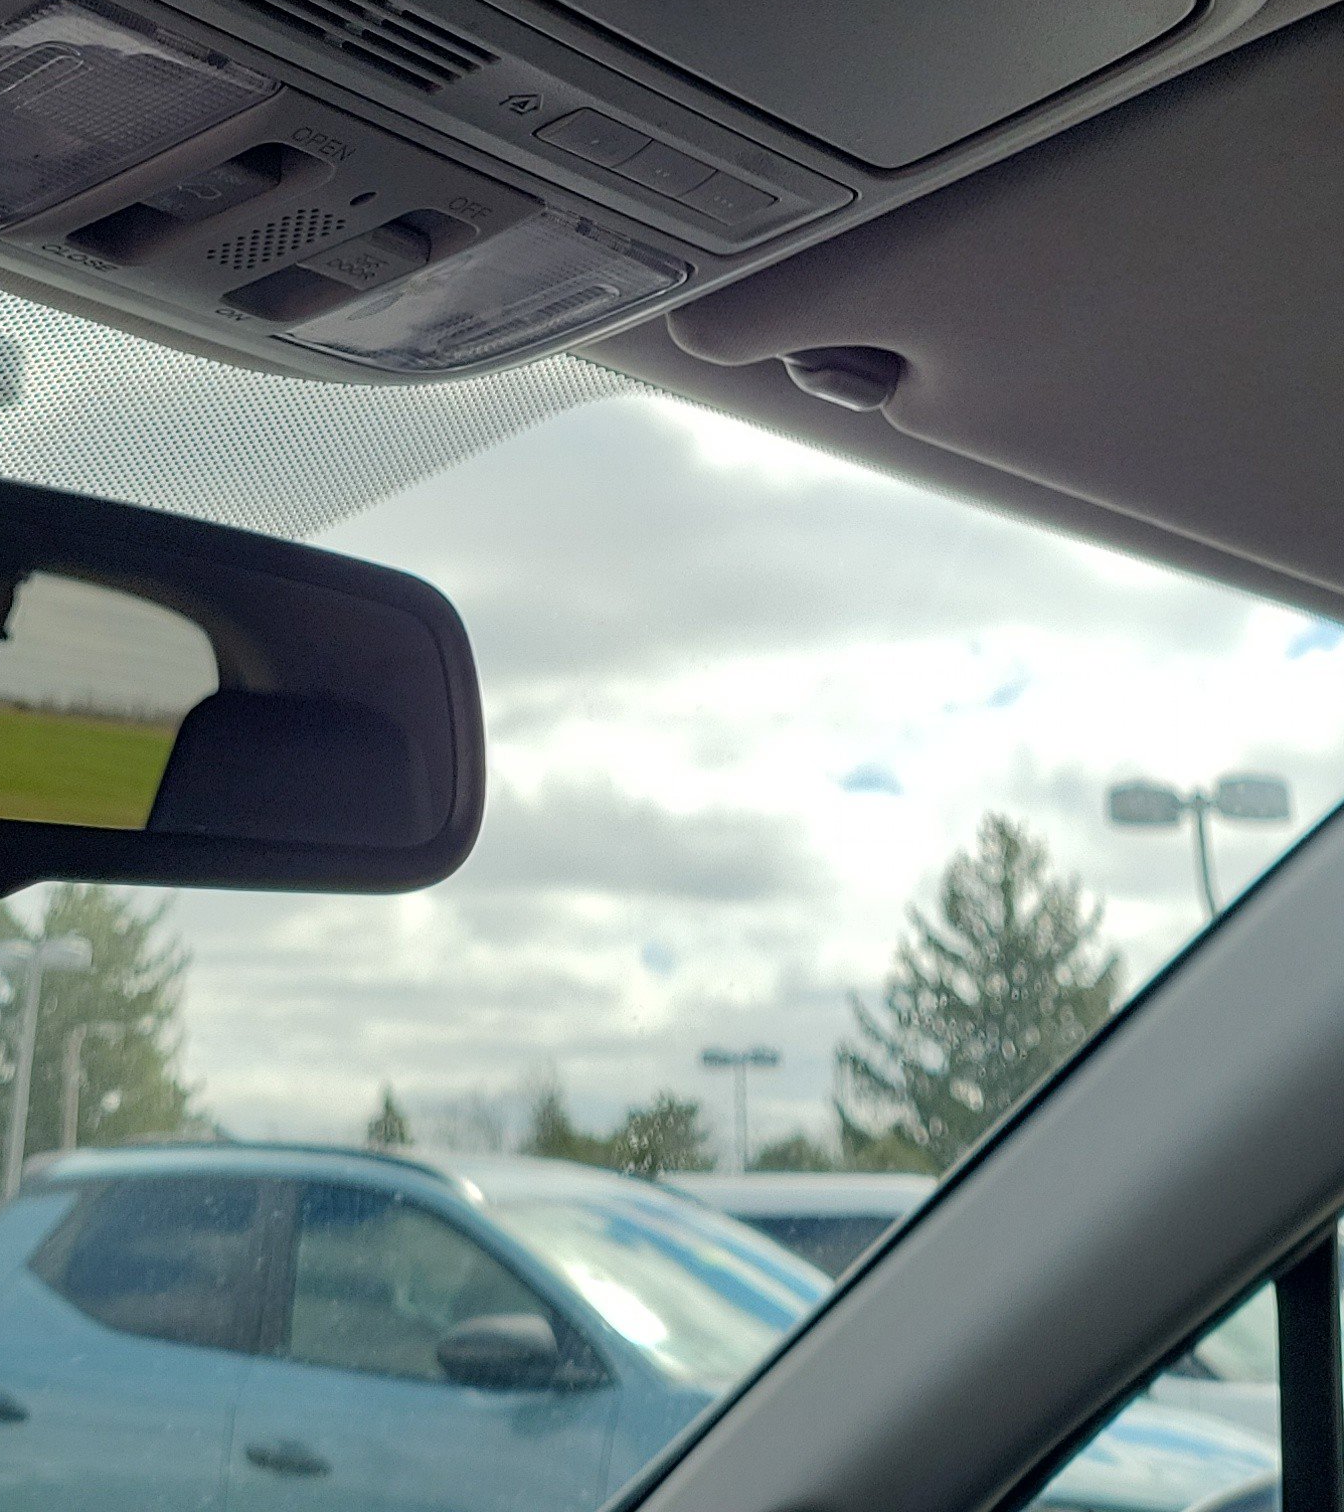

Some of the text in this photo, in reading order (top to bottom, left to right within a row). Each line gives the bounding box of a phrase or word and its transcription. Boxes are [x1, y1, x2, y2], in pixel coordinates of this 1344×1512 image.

[291, 126, 355, 162] OPEN
[448, 196, 493, 220] OFF
[41, 243, 121, 274] CLOSE
[215, 307, 252, 322] ON
